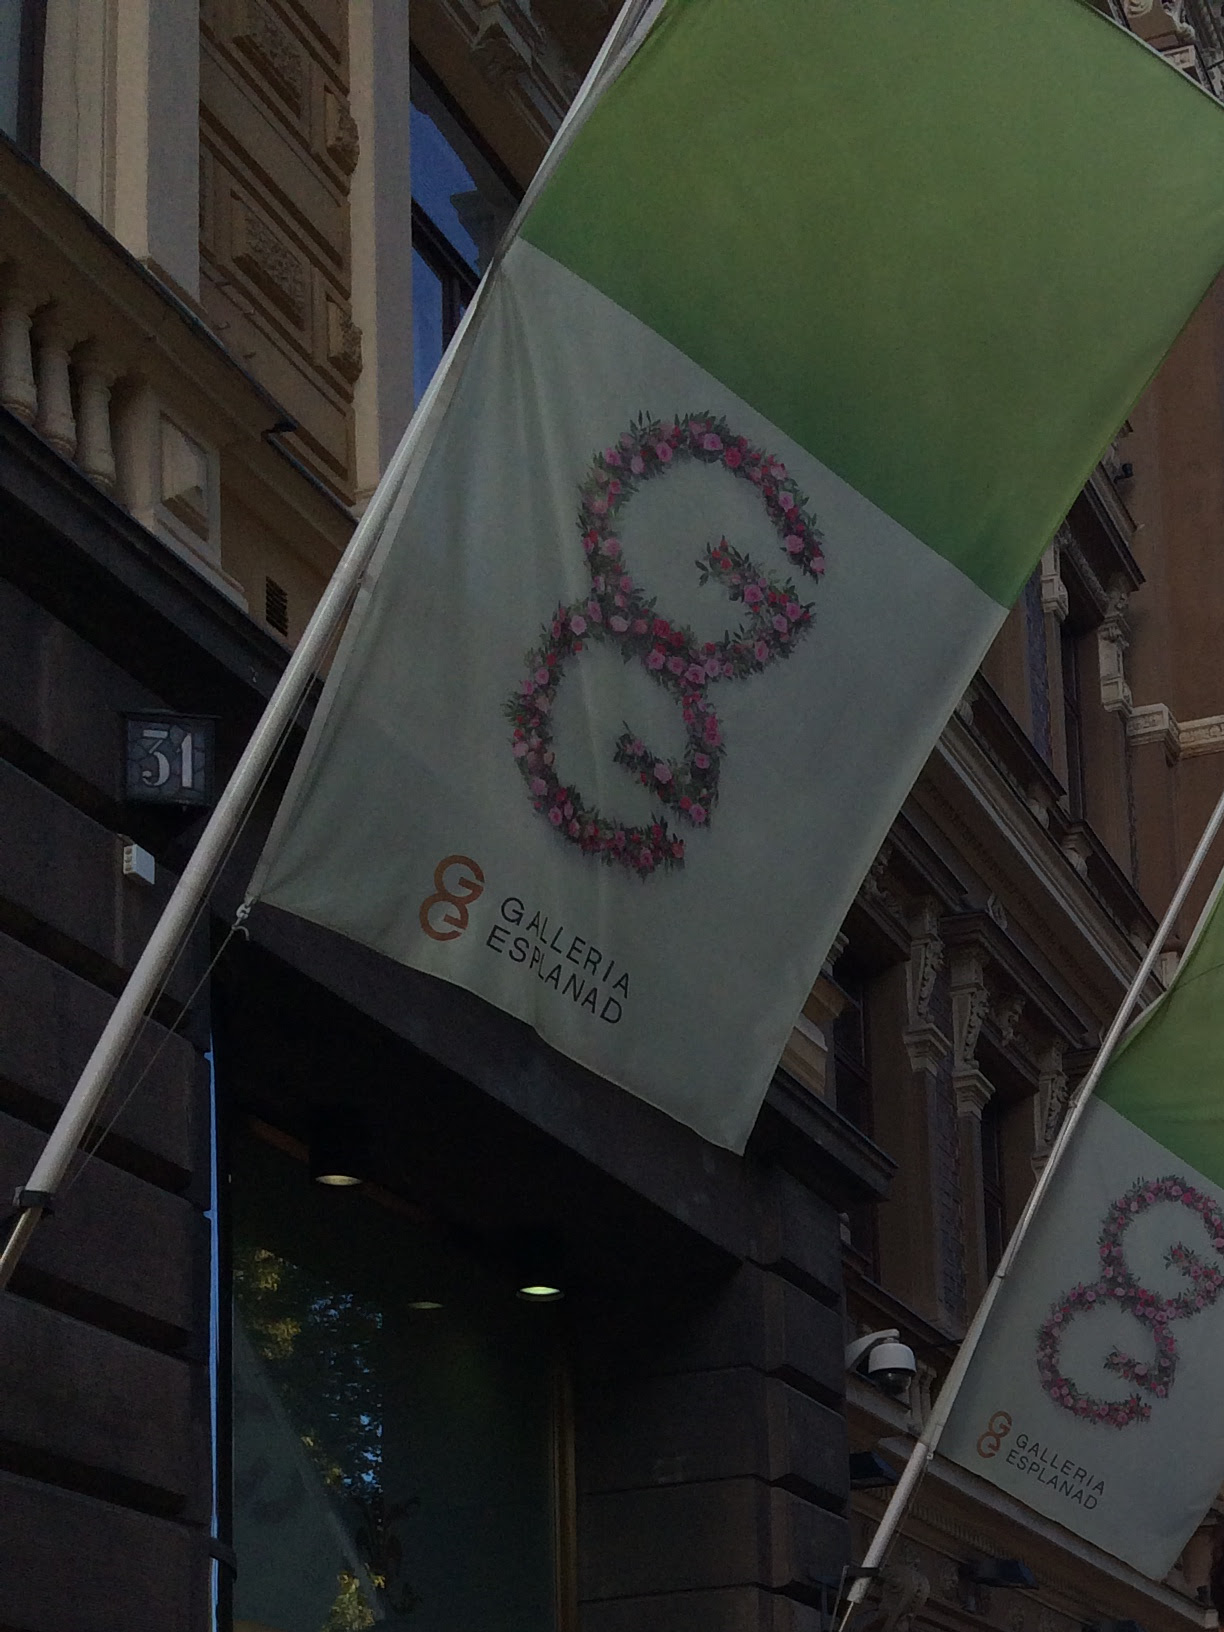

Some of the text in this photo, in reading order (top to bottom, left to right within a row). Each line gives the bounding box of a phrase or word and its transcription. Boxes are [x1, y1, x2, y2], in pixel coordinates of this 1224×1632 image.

[142, 729, 193, 788] 31
[486, 925, 622, 1024] ESPLANAD
[501, 897, 630, 999] GALLERIA
[1006, 1449, 1098, 1510] ESPLANAD
[1016, 1434, 1105, 1495] GALLERIA
